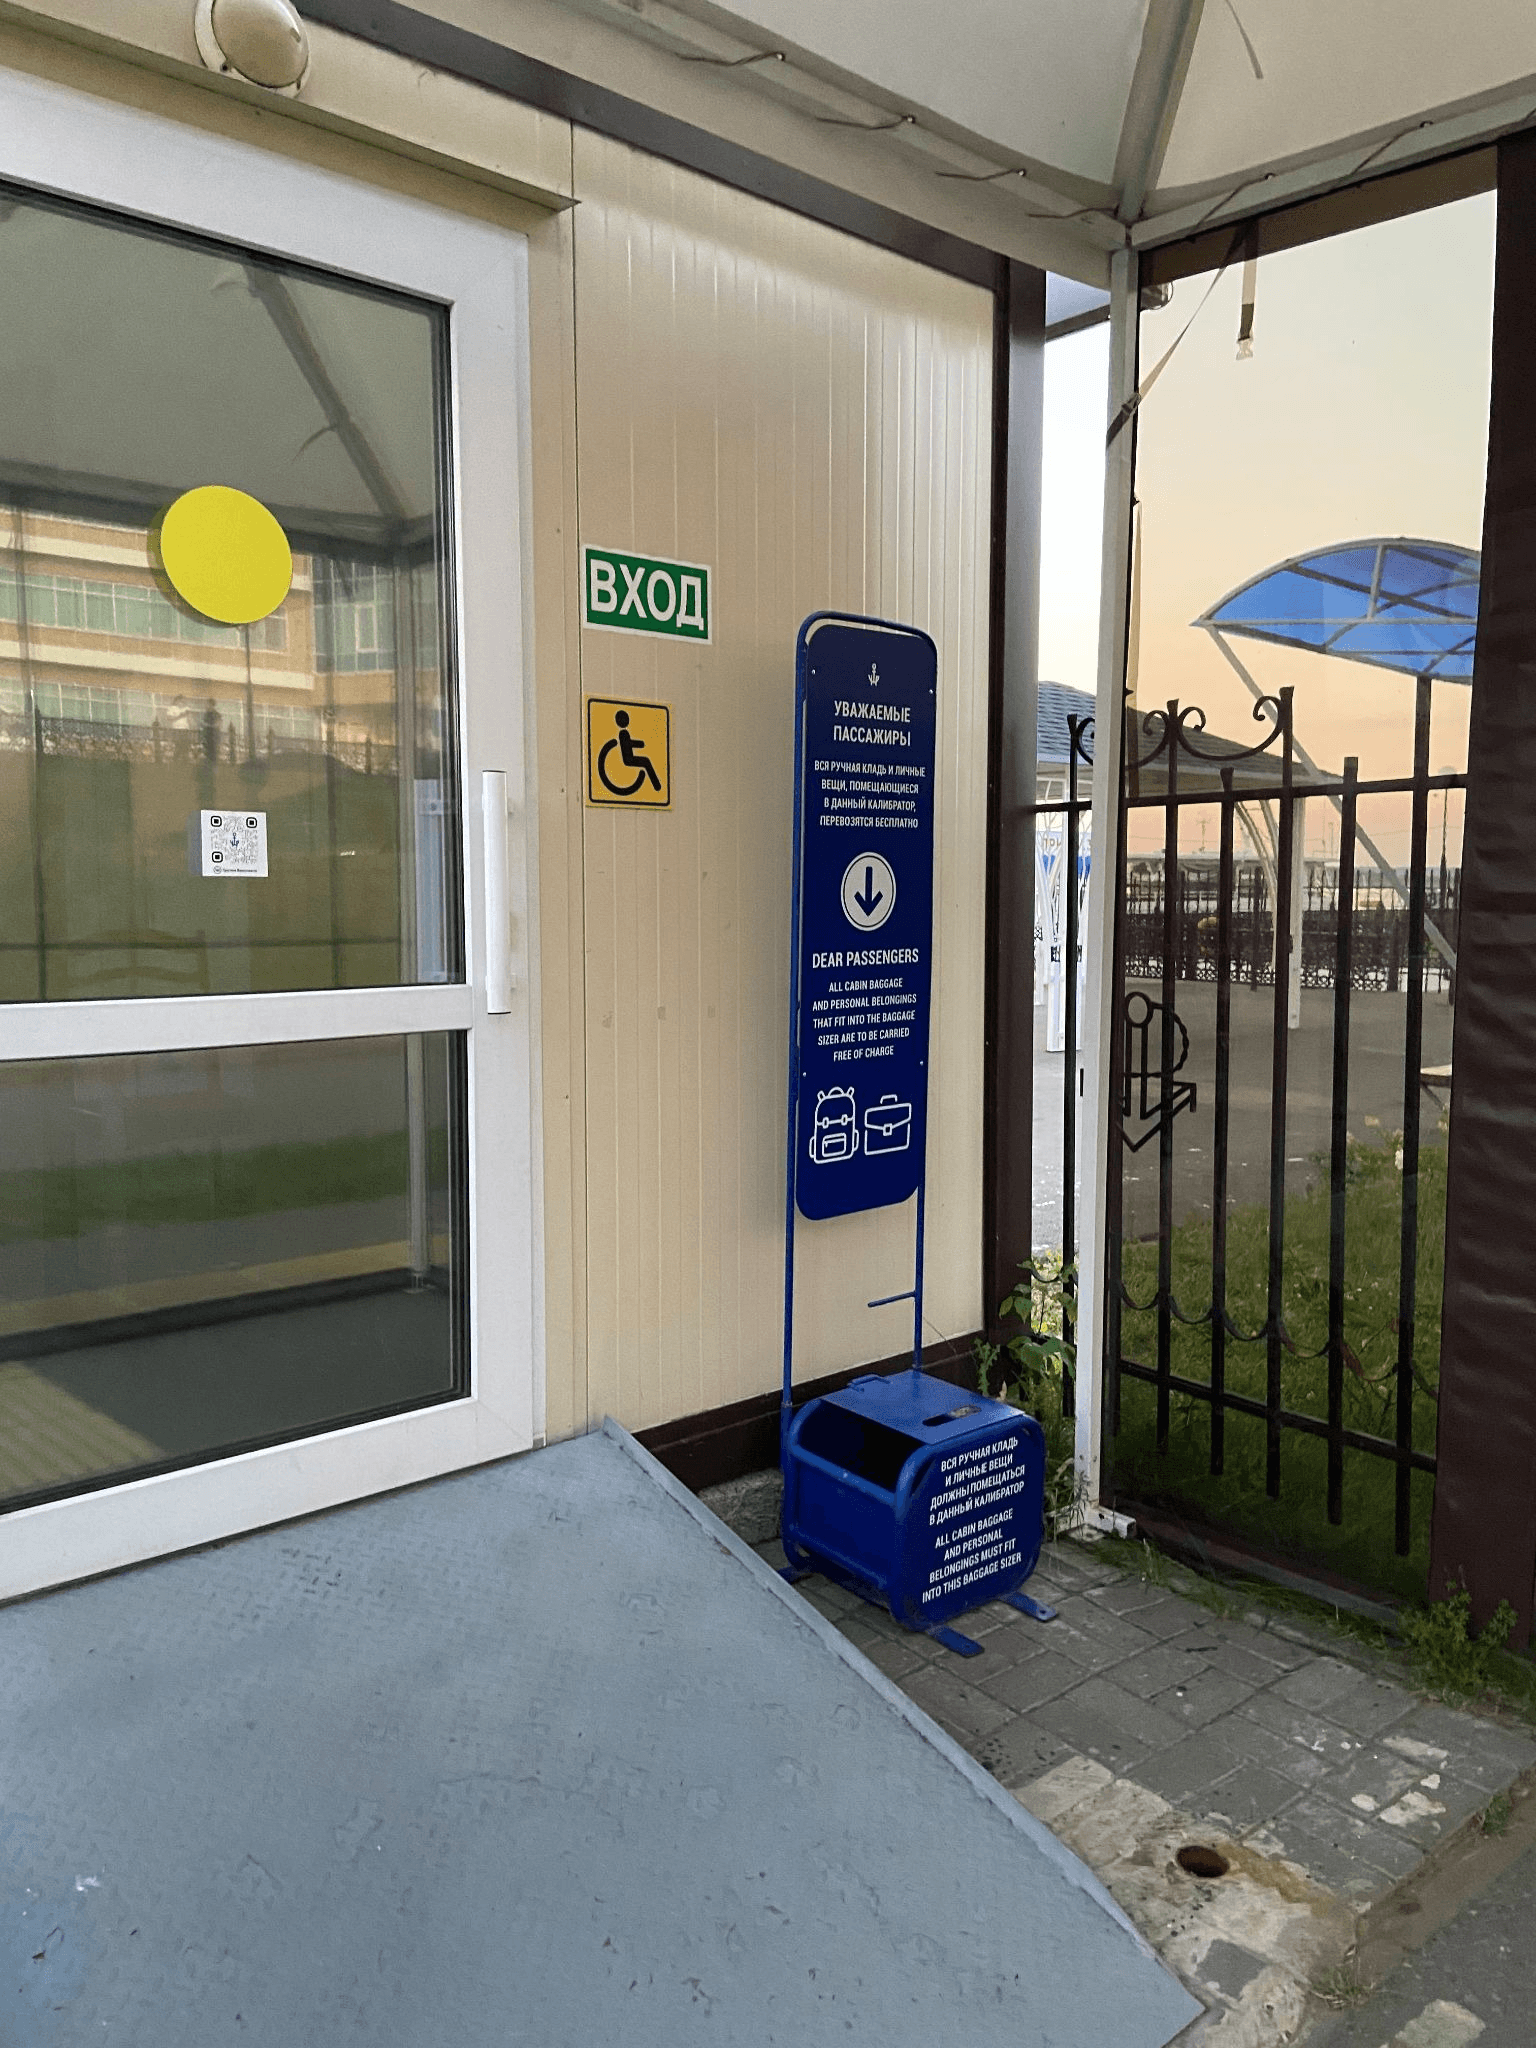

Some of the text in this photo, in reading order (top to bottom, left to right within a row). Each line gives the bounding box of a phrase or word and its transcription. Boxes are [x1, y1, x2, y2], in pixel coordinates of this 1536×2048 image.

[590, 558, 704, 631] ВХОД
[834, 700, 911, 723] УВАЖАЕМЫЕ
[833, 725, 911, 746] ПАССАЖИРЫ
[814, 760, 926, 777] ВСЯ РУЧНАЯ КЛАДЬ И ЛИЧНЫЕ
[822, 779, 919, 795] ВЕЩИ, ПОМЕЩАЮЩИЕСЯ
[824, 796, 916, 812] В ДАННЫЙ КАЛИБРАТОР,
[820, 815, 918, 828] ПЕРЕВОЗЯТСЯ БЕСПЛАТНО
[812, 948, 919, 968] DEAR PASSENGERS
[829, 978, 903, 993] ALL CABIN BAGGAGE
[812, 993, 917, 1012] AND PERSONAL BELONGINGS
[813, 1010, 916, 1029] THAT FIT INTO THE BAGGAGE
[818, 1027, 910, 1046] SIZER ARE TO BE CARRIED
[834, 1046, 894, 1062] FREE OF CHARGE
[941, 1436, 1019, 1472] ВСЯ РУЧНАЯ КЛАДЬ
[945, 1453, 1013, 1487] И ЛИЧНЫЕ ВЕЩИ
[930, 1465, 1025, 1512] ДОЛЖНЫ ПОМЕЩАТЬСЯ
[929, 1481, 1025, 1526] В ДАННЫЙ КАЛИБРАТОР
[935, 1508, 1013, 1549] ALL CABIN BAGGAGE
[943, 1528, 1003, 1561] AND PERSONAL
[929, 1538, 1017, 1583] BELONGINGS MUST FIT
[922, 1552, 1022, 1603] INTO THIS BAGGAGE SIZER
